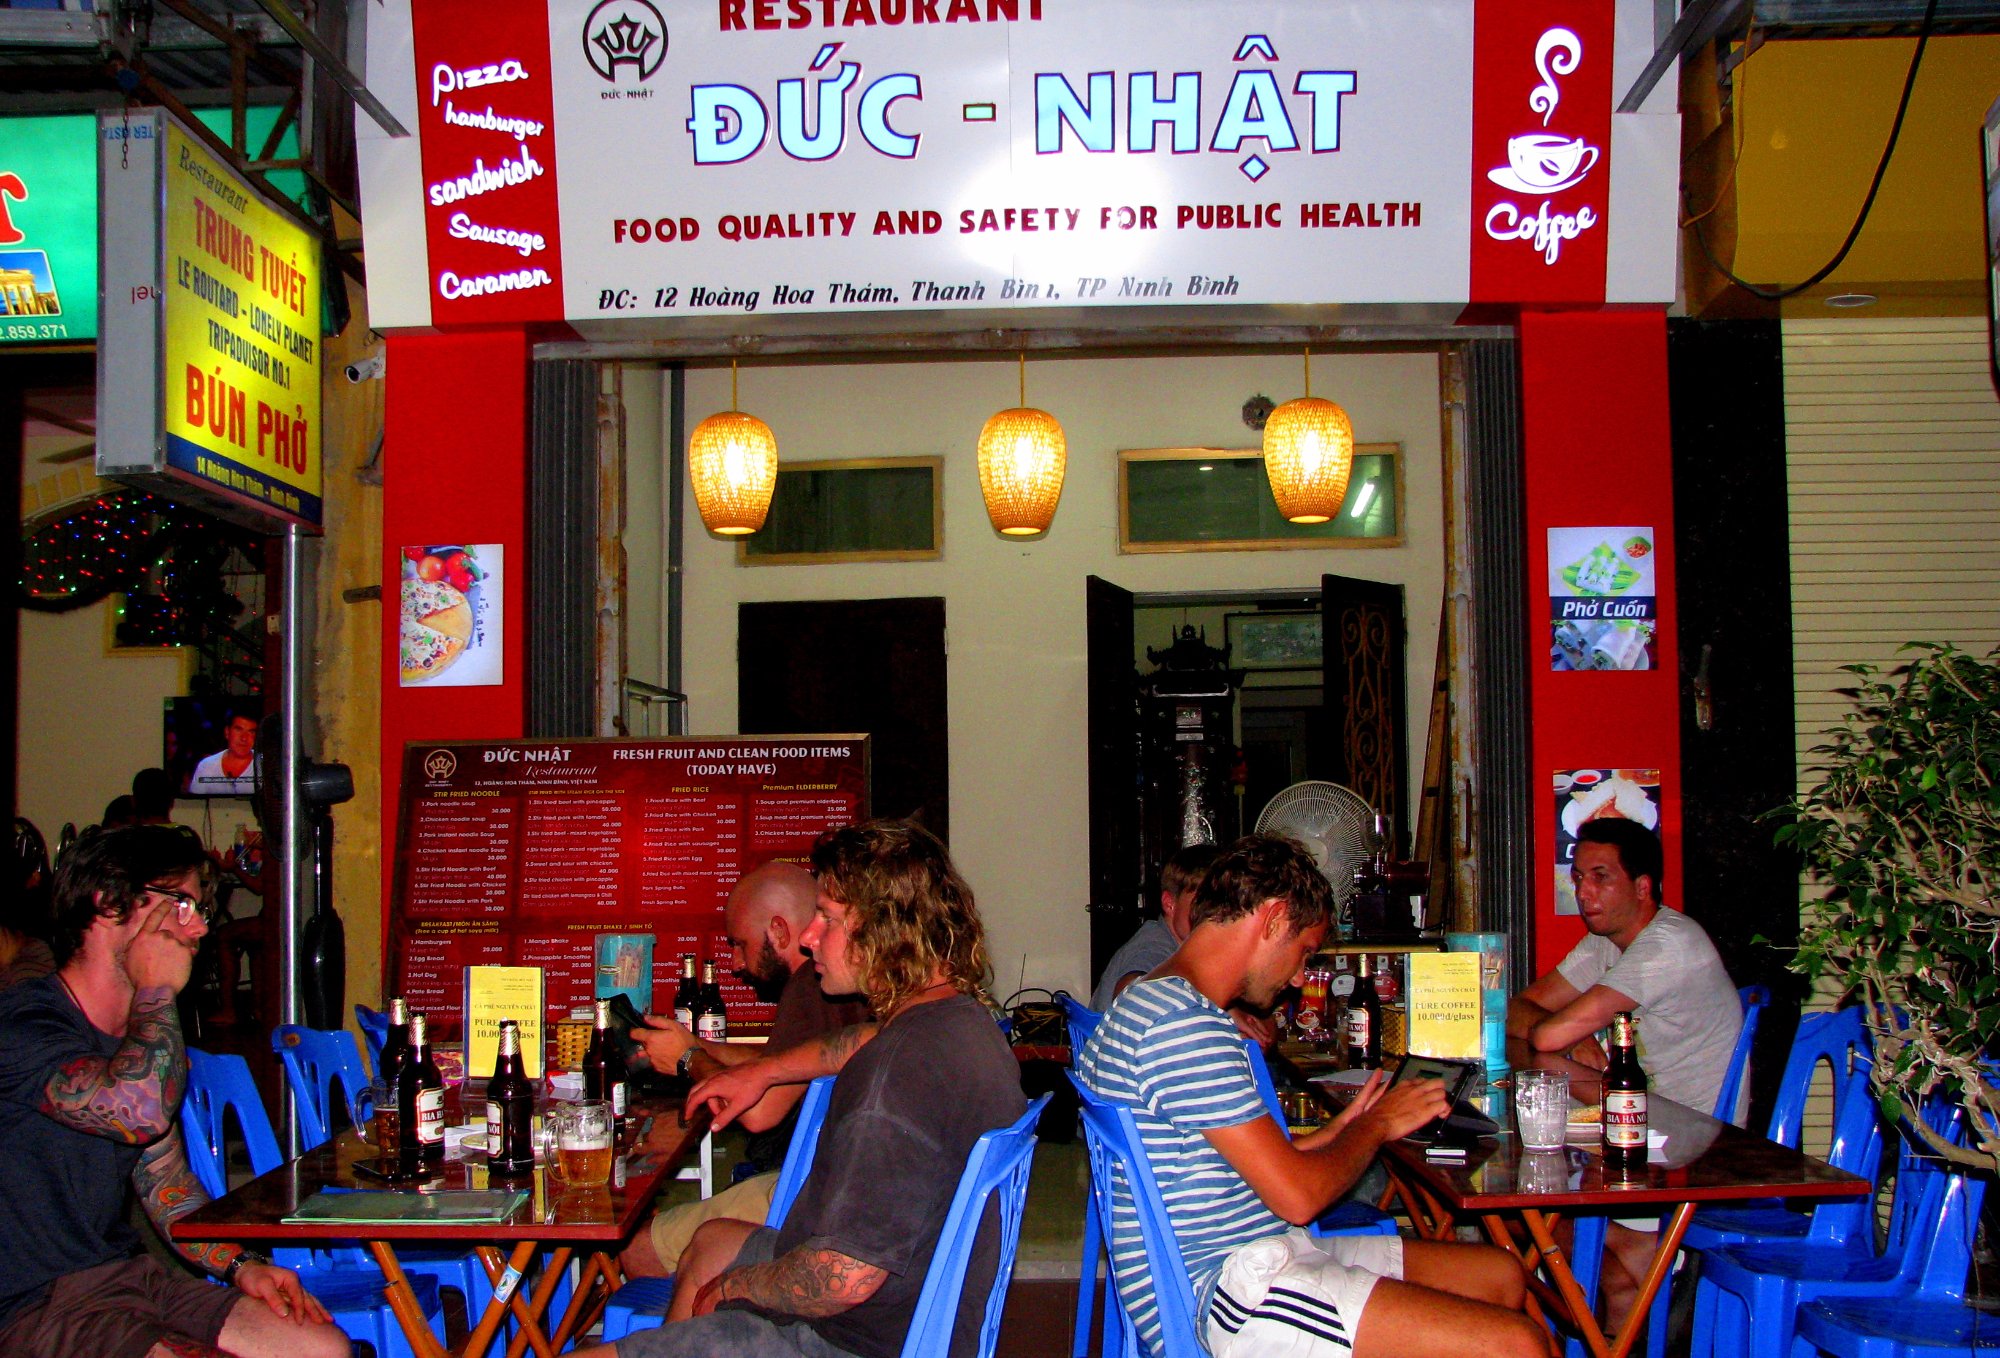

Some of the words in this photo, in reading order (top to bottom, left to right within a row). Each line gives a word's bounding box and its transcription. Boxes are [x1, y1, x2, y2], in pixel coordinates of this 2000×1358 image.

[432, 60, 529, 107] Pizza
[445, 101, 545, 141] hamburger
[686, 42, 923, 166] ĐỨC
[1034, 34, 1358, 184] NHẬT
[179, 144, 249, 215] Restaurant
[429, 144, 544, 206] sandwich
[448, 212, 546, 257] Sausage
[613, 218, 700, 243] FOOD
[718, 212, 857, 242] QUALITY
[873, 210, 943, 235] AND
[959, 207, 1081, 232] SAFETY
[1100, 205, 1158, 230] FOR
[1177, 203, 1282, 229] PUBLIC
[1300, 202, 1421, 228] HEALTH
[1485, 200, 1597, 265] Coffee
[193, 196, 254, 283] TRUNG
[260, 252, 307, 317] TUYẾT
[439, 268, 552, 300] Caramen
[599, 289, 638, 309] ĐC:
[654, 287, 678, 308] 12
[689, 286, 760, 312] Hoàng
[772, 285, 815, 305] Hoa
[829, 283, 899, 304] Thám,
[912, 281, 986, 303] Thanh
[1077, 277, 1107, 298] TP
[1186, 275, 1239, 297] Bình
[177, 255, 191, 290] LE
[193, 265, 239, 319] ROUTARD
[250, 303, 282, 346] LONELY
[284, 324, 313, 365] PLANET
[208, 318, 270, 379] TRIPADVISOR
[186, 365, 246, 448] BÚN
[257, 403, 308, 475] PHỞ
[1562, 599, 1599, 617] Phở
[1602, 599, 1647, 617] Cuốn
[483, 747, 520, 763] ĐỨC
[524, 746, 572, 764] NHẬT
[523, 766, 597, 778] Restaurant
[613, 749, 654, 760] FRESH
[657, 749, 695, 760] FRUIT
[697, 749, 726, 759] AND
[728, 748, 769, 759] CLEAN
[772, 747, 808, 758] FOOD
[810, 747, 851, 758] ITEMS
[686, 764, 734, 776] (TODAY
[737, 763, 777, 776] HAVE)
[475, 1018, 499, 1026] PURE
[1441, 1001, 1477, 1010] COFFEE
[422, 1112, 436, 1122] BIA
